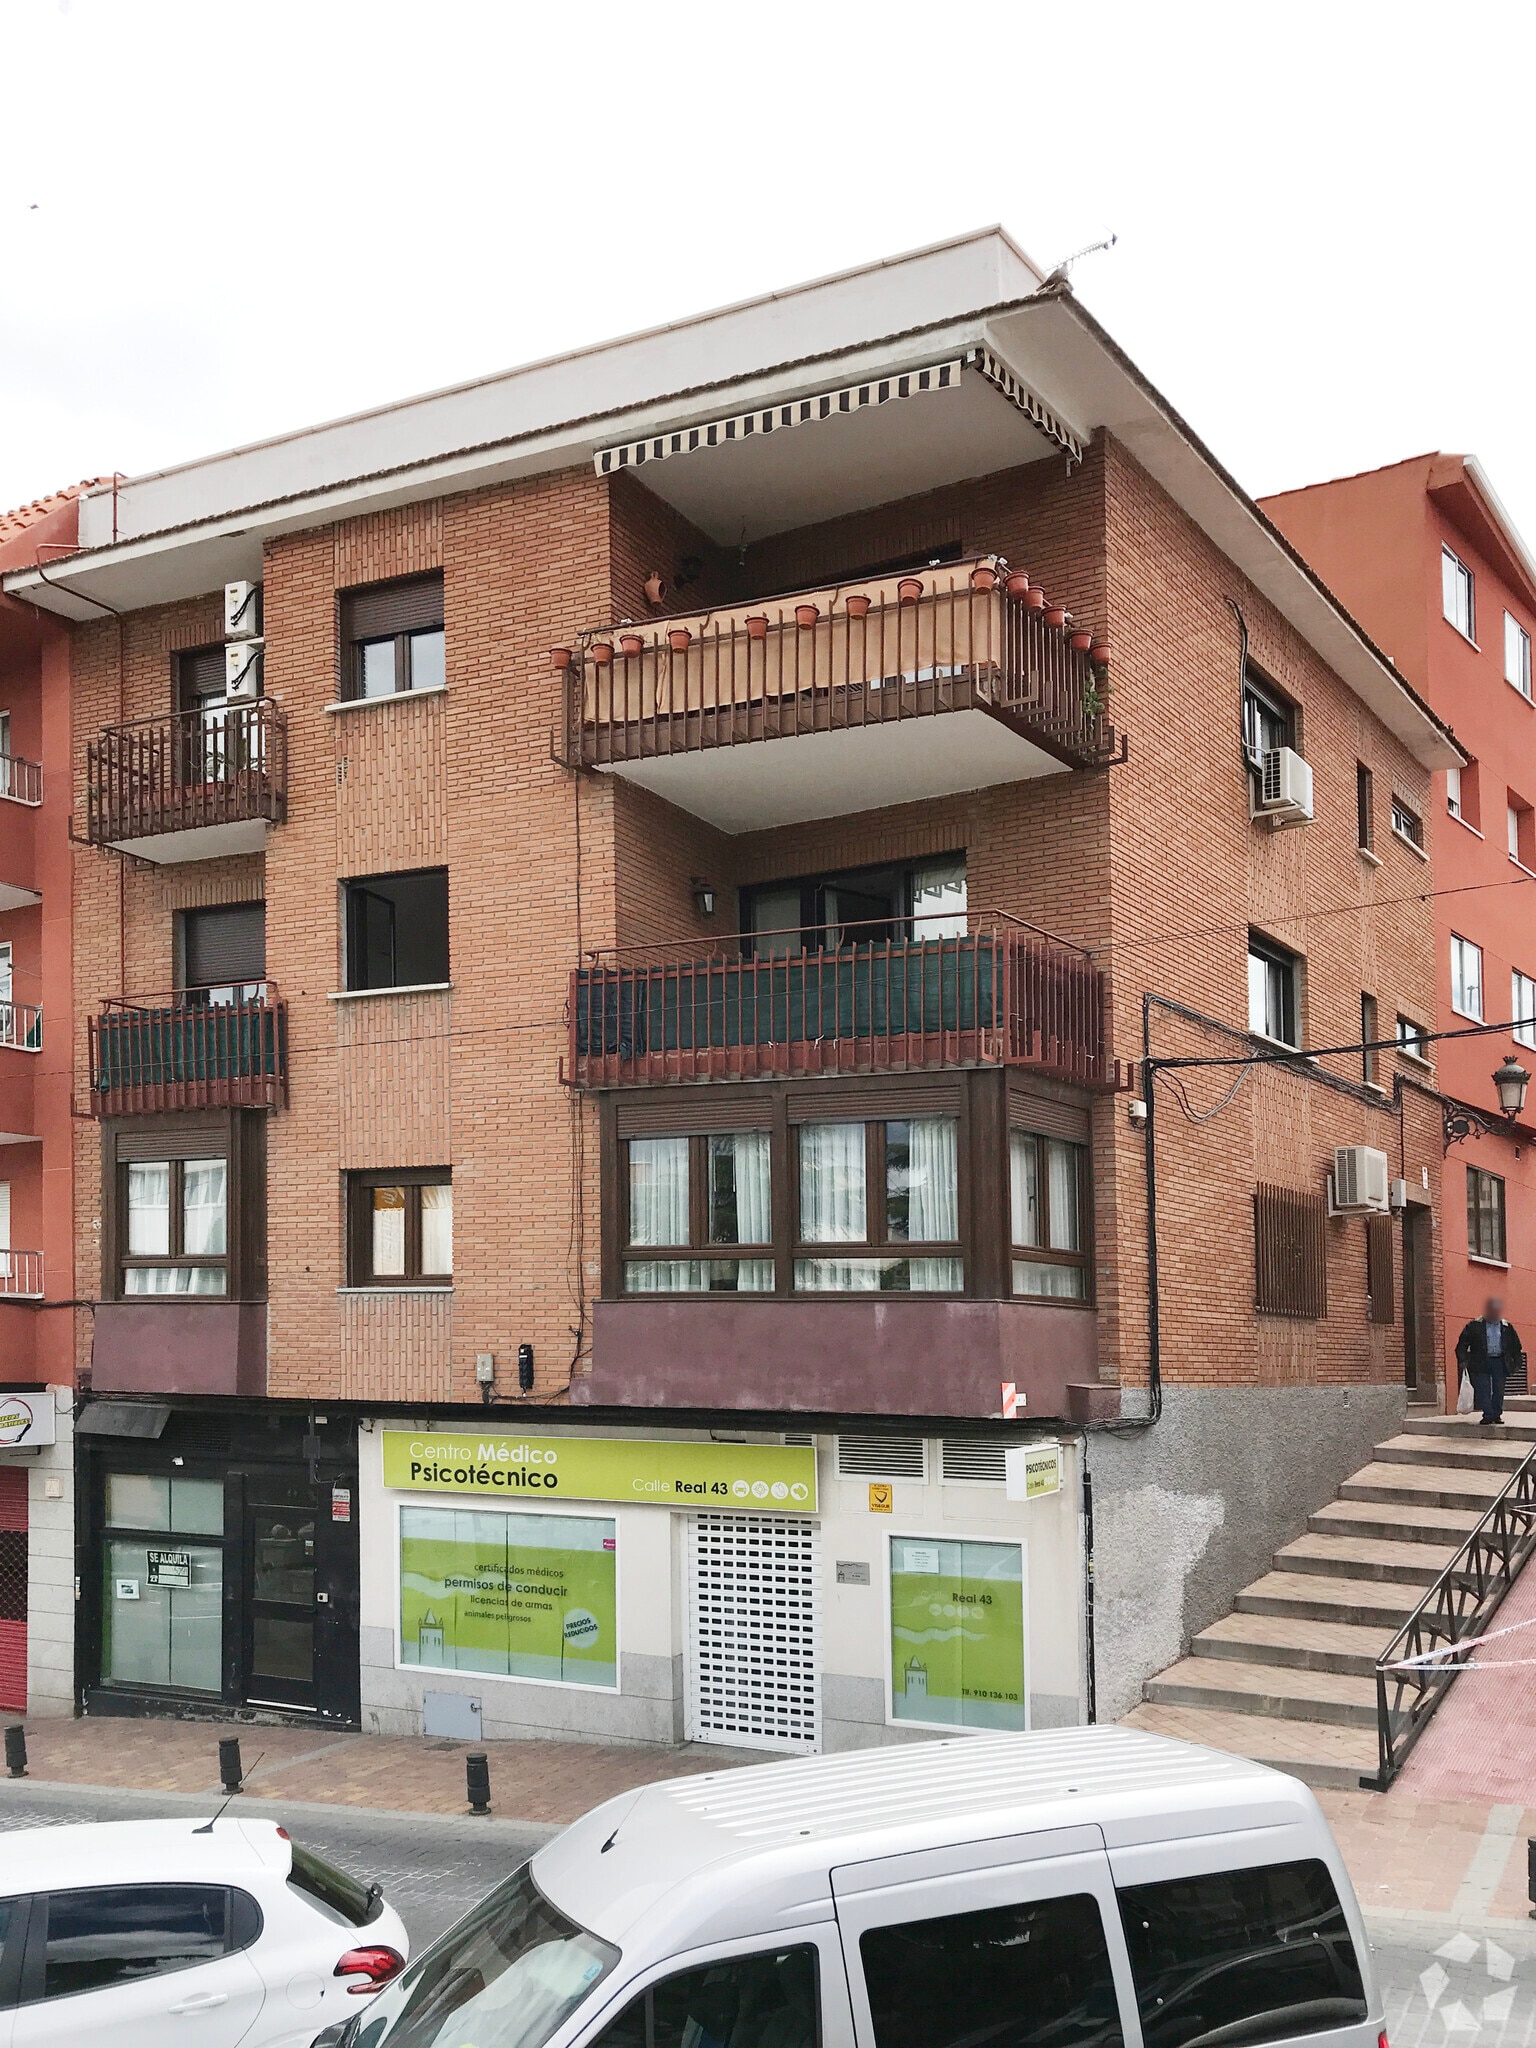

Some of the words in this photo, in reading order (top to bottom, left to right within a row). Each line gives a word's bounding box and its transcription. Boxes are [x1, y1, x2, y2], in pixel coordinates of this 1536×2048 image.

[409, 1441, 472, 1461] Centro
[477, 1442, 558, 1465] Médico
[410, 1462, 559, 1489] Psicotécnico
[632, 1478, 671, 1493] Calle
[675, 1480, 707, 1494] Real
[710, 1482, 729, 1495] 43
[149, 1552, 160, 1564] SE
[160, 1553, 188, 1566] ALQUILA
[474, 1563, 525, 1576] certificados
[526, 1567, 565, 1579] médicos
[444, 1578, 494, 1591] permisos
[497, 1581, 513, 1592] de
[515, 1583, 568, 1598] conducir
[470, 1594, 509, 1607] licencias
[511, 1599, 523, 1609] de
[524, 1602, 554, 1612] armas
[952, 1592, 977, 1604] Real
[979, 1594, 993, 1606] 43
[464, 1610, 495, 1619] animales
[495, 1611, 532, 1624] peligrosos
[565, 1617, 591, 1630] PRECIOS
[564, 1623, 599, 1639] REDUCIDOS
